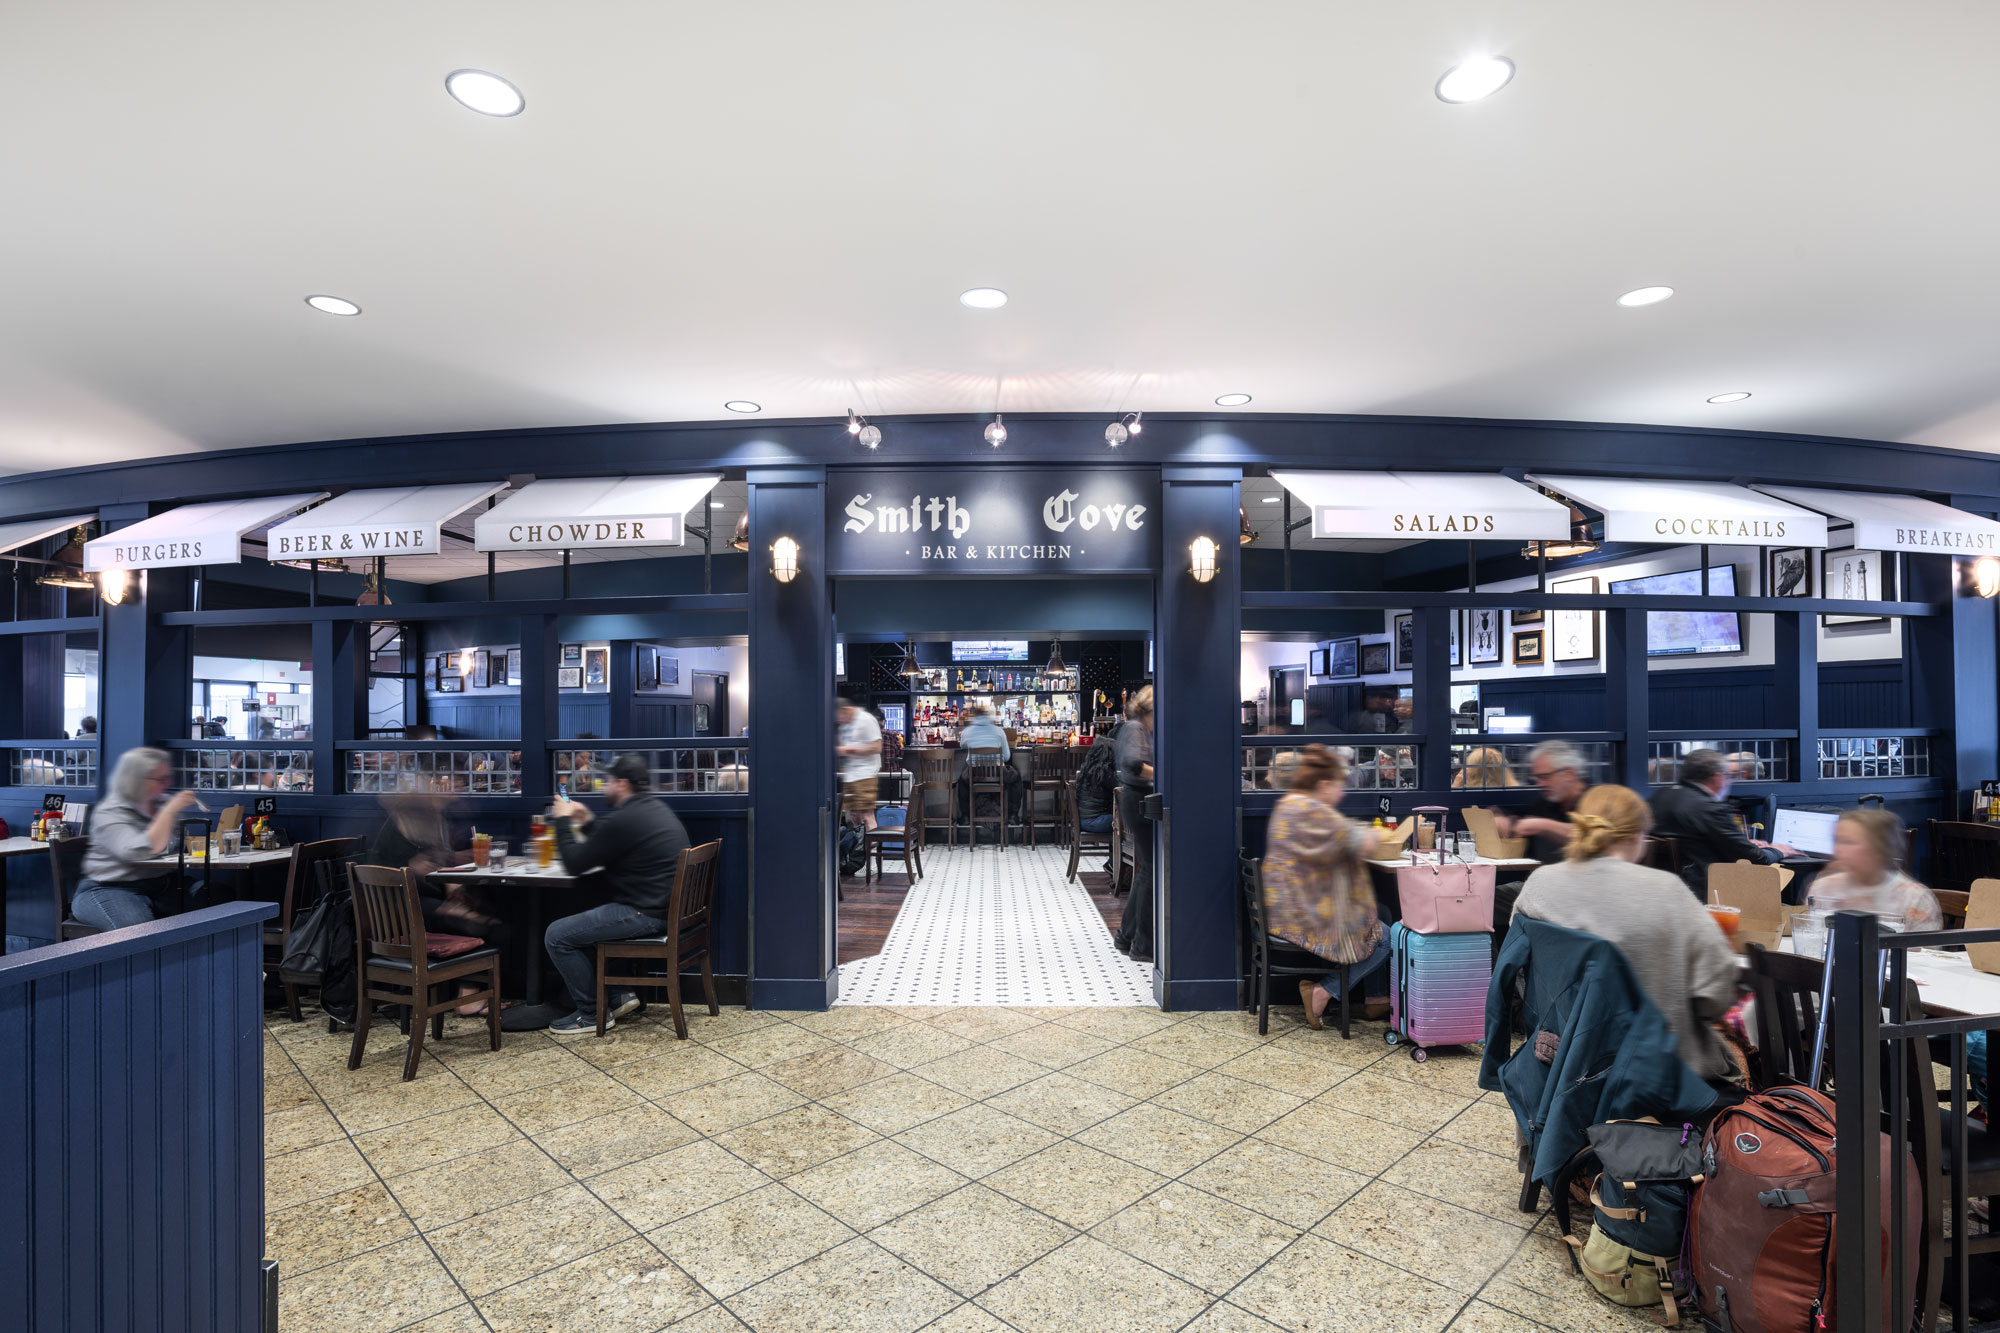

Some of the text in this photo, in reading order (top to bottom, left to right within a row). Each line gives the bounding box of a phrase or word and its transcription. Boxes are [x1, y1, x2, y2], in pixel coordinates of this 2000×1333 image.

[844, 488, 1147, 539] Smith Cove
[1394, 514, 1494, 532] SALADS
[510, 522, 645, 543] CHOWDER
[1655, 518, 1786, 538] COCKTAILS
[279, 529, 422, 553] BEER & WINE
[1896, 528, 1996, 549] BREAKFAST
[114, 542, 202, 563] BURGERS
[921, 545, 1072, 559] BAR & KITCHEN
[46, 796, 62, 809] 46
[257, 799, 274, 812] 45
[1380, 798, 1390, 812] 43
